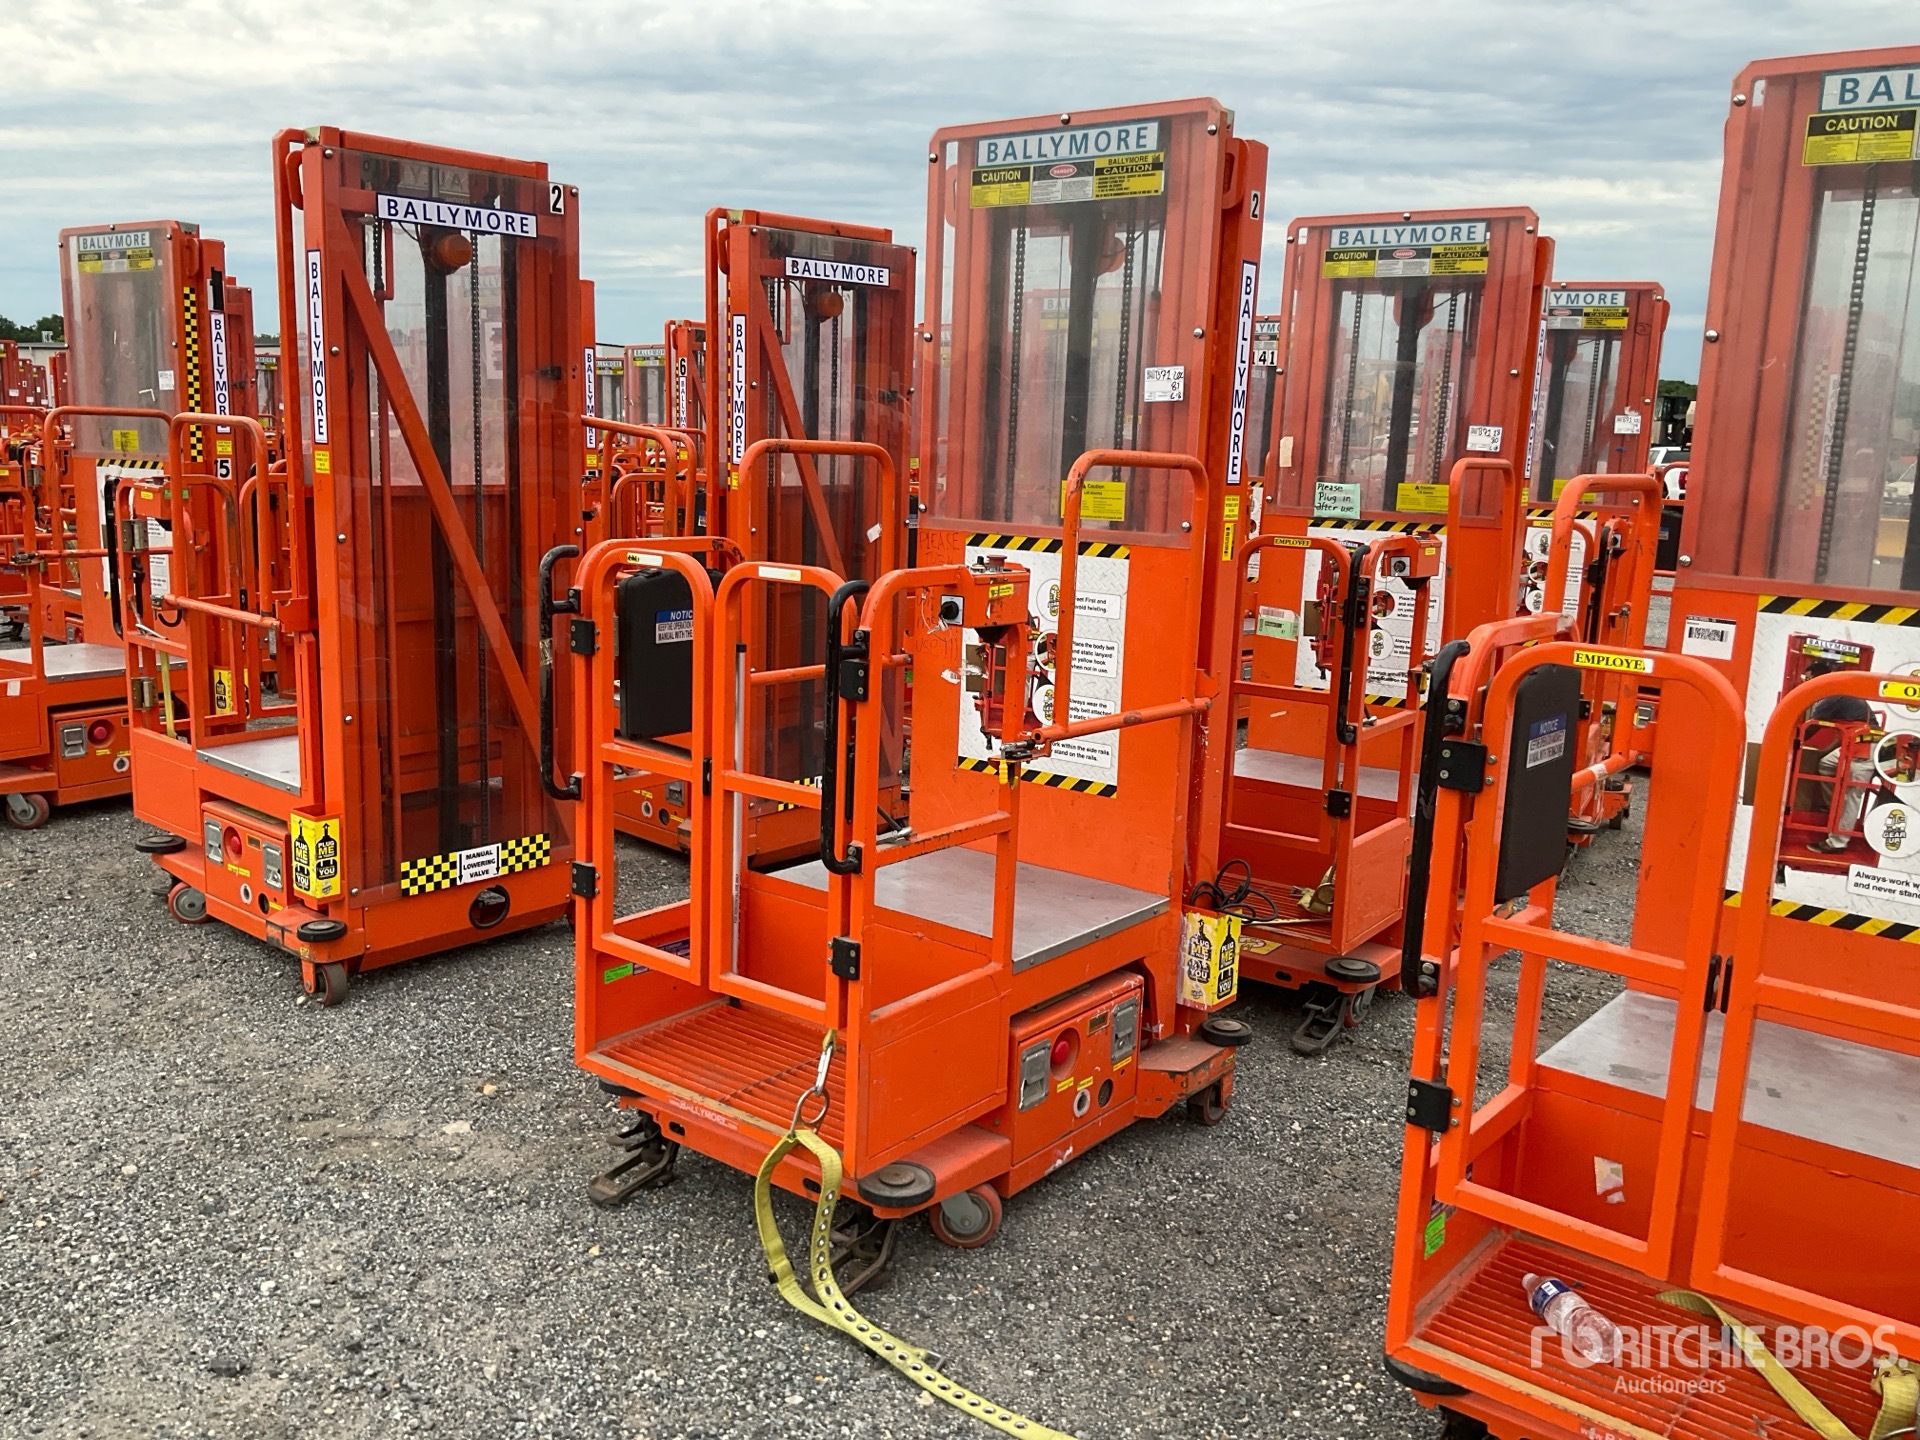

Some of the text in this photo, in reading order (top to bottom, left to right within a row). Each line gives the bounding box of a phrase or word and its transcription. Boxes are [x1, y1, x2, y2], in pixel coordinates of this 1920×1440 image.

[1838, 73, 1920, 105] BAL
[1825, 115, 1899, 132] CAUTION
[987, 126, 1149, 163] BALLYMORE
[1108, 155, 1149, 166] BALLYMORE
[1103, 163, 1153, 175] CAUTION
[981, 170, 1021, 183] CAUTION
[551, 185, 562, 213] 2
[1250, 193, 1259, 219] 2
[386, 198, 530, 234] BALLYMORE
[82, 233, 147, 250] BALLYMORE
[1338, 225, 1478, 246] BALLYMORE
[1333, 252, 1368, 260] CAUTION
[791, 261, 885, 284] BALLYMORE
[1256, 324, 1280, 332] YM
[311, 262, 324, 435] BALLYMORE
[680, 358, 686, 375] 6
[214, 319, 227, 427] BALLYMOR
[1231, 275, 1252, 475] BALLYMORE
[735, 324, 744, 458] BALLYMORE
[1317, 483, 1343, 492] Please
[1319, 492, 1336, 504] Plug
[1315, 502, 1338, 511] after
[919, 530, 960, 551] PLEASE
[673, 620, 692, 630] OPERATION
[658, 631, 675, 641] MANUAL
[675, 630, 685, 639] WITH
[1809, 640, 1857, 653] BALLYMORE
[1575, 652, 1646, 671] EMPLOYE
[1540, 719, 1559, 734] NOTICE
[1882, 831, 1907, 839] GEAR
[295, 840, 307, 850] PLUG
[318, 840, 335, 848] PLUG
[318, 845, 335, 855] ME
[295, 847, 308, 859] ME
[466, 850, 493, 860] MANUAL
[463, 858, 495, 870] LOWERING
[319, 867, 335, 876] YOU
[470, 869, 489, 878] VALVE
[296, 874, 308, 885] YOU
[1855, 871, 1887, 883] Always
[1889, 879, 1910, 887] work
[1872, 886, 1897, 894] never
[1191, 937, 1210, 948] PLUG
[1221, 941, 1234, 952] PLUG
[1191, 945, 1209, 955] ME
[1222, 950, 1233, 961] ME
[1190, 969, 1207, 979] YOU
[1220, 980, 1232, 992] YOU
[679, 1100, 727, 1127] BALLYMORE
